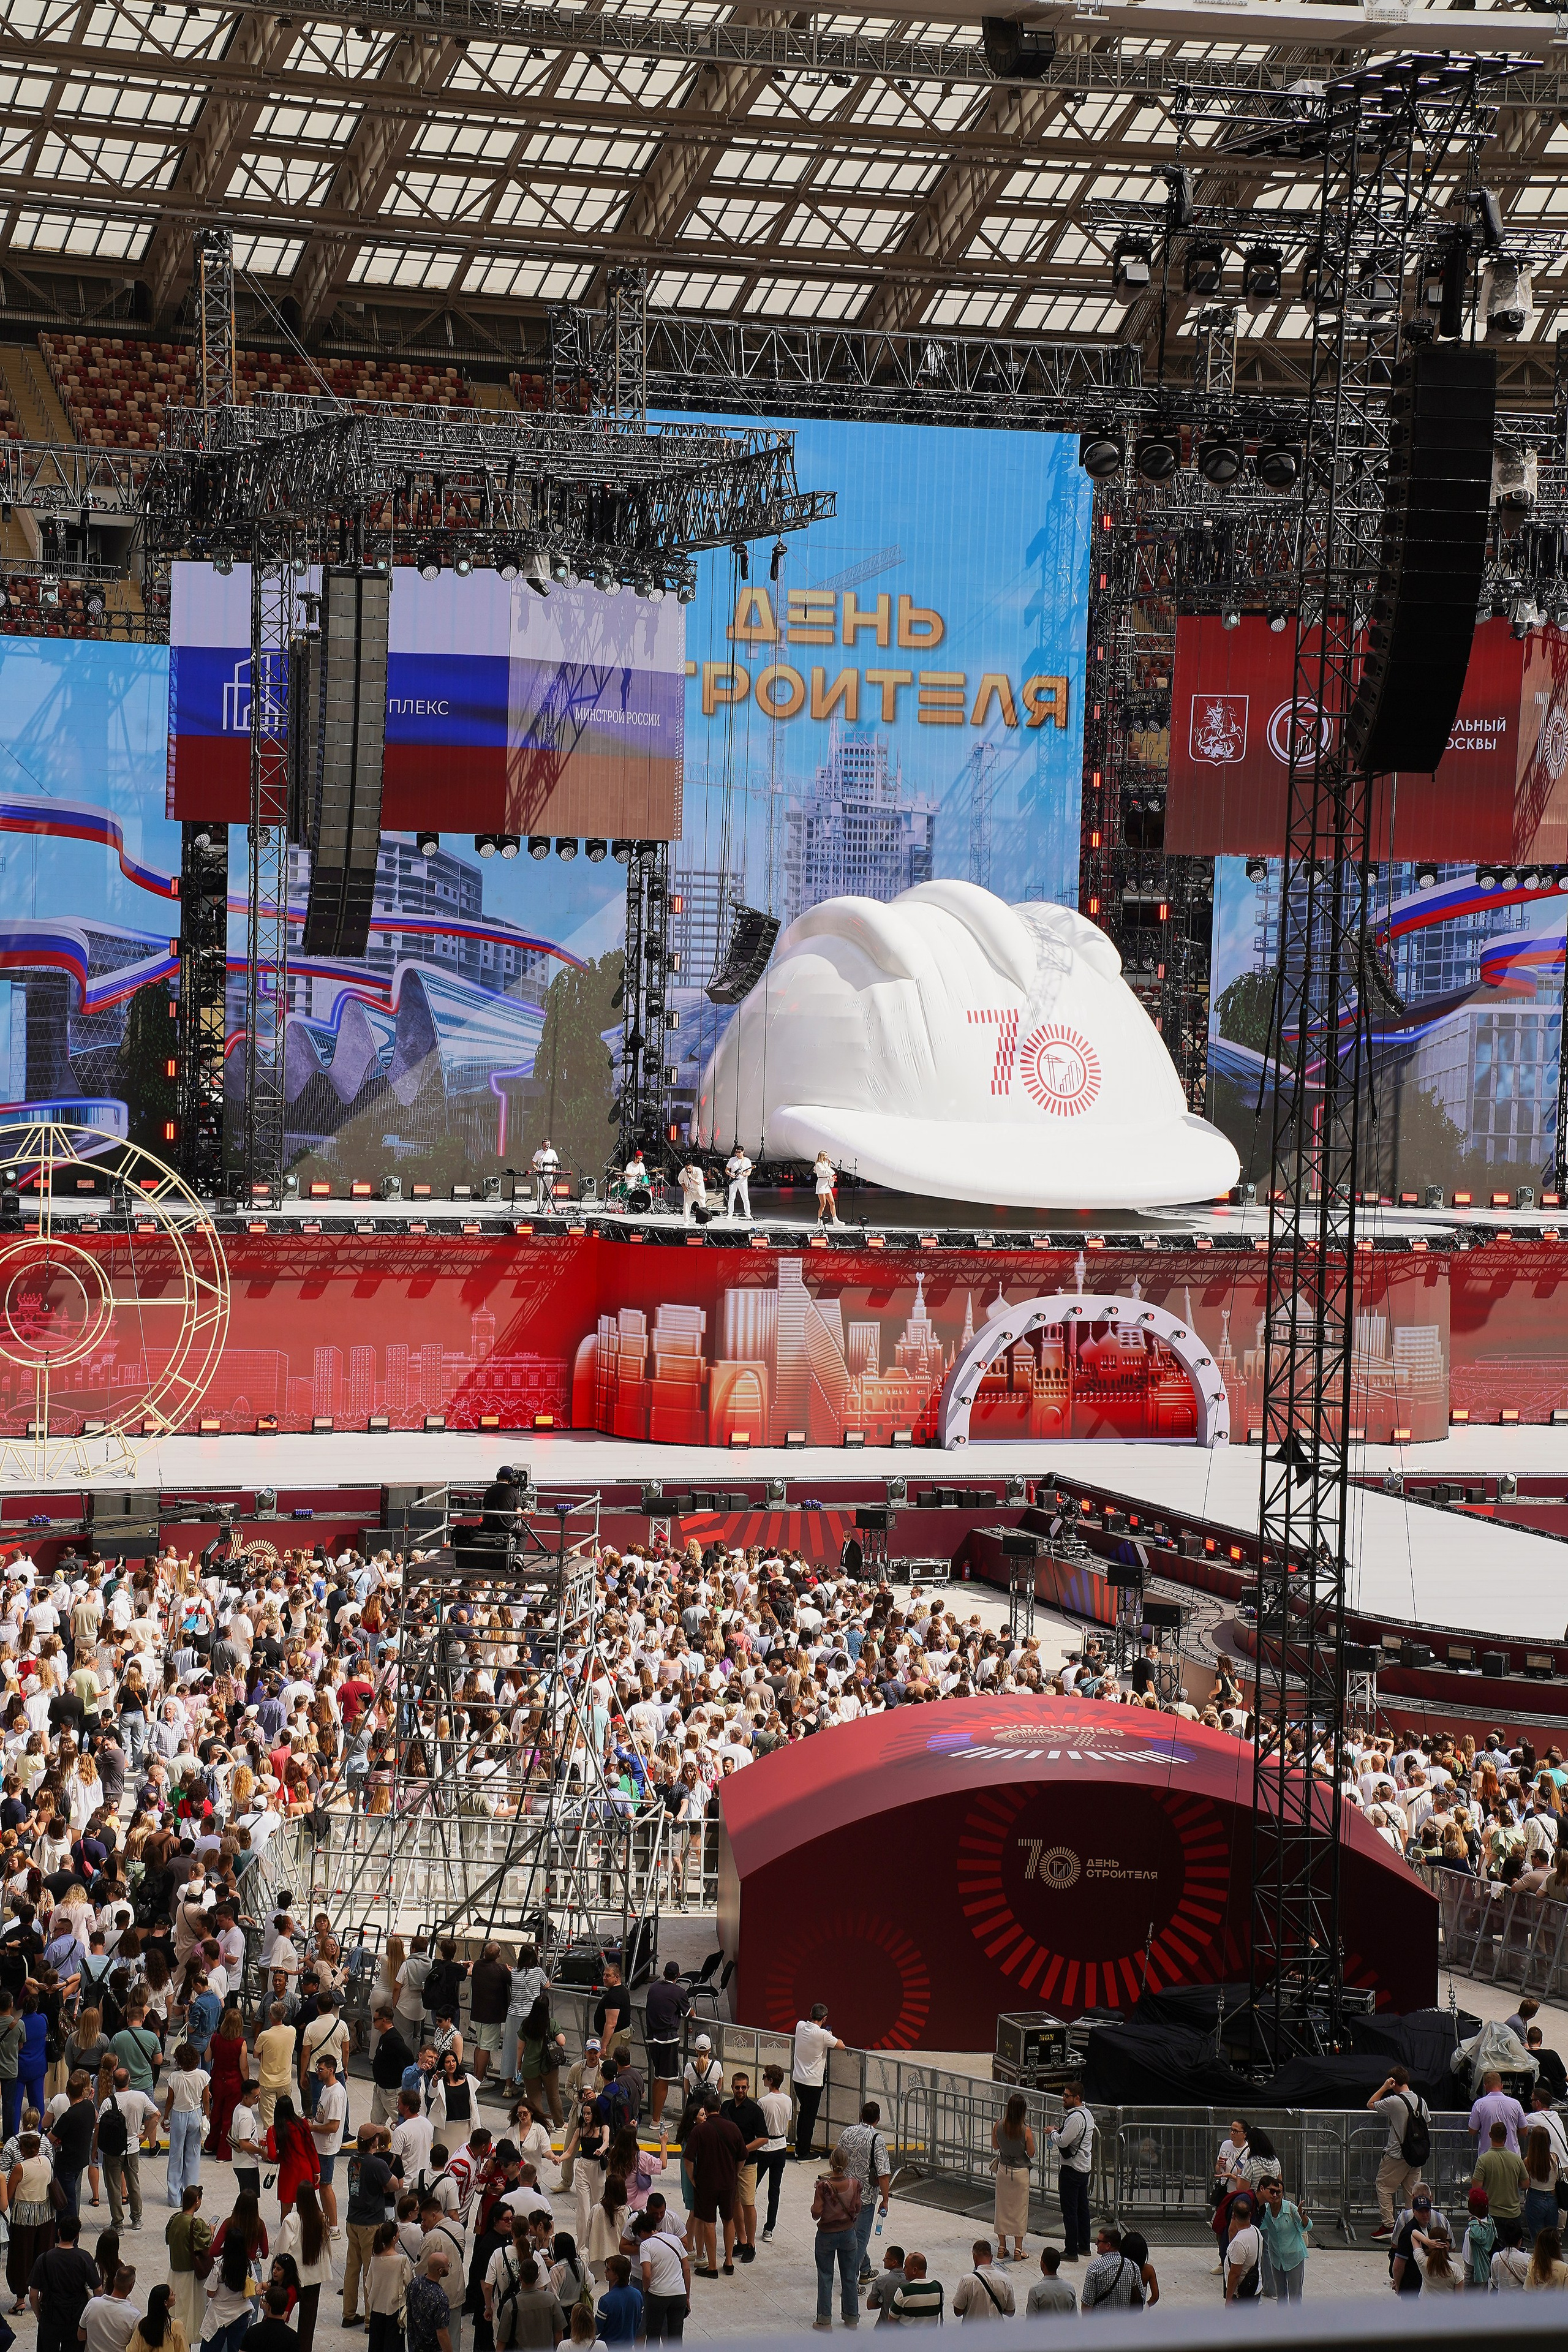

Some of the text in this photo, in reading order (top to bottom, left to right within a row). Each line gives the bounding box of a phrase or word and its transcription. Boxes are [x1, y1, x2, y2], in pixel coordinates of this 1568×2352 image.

[725, 586, 945, 648] ДЕНЬ
[386, 699, 449, 715] ПЛЕКС
[575, 707, 660, 726] МИНСТРОЙ РОССИИ
[1086, 1858, 1120, 1868] ДЕНЬ
[1086, 1869, 1158, 1880] СТРОИТЕЛЯ
